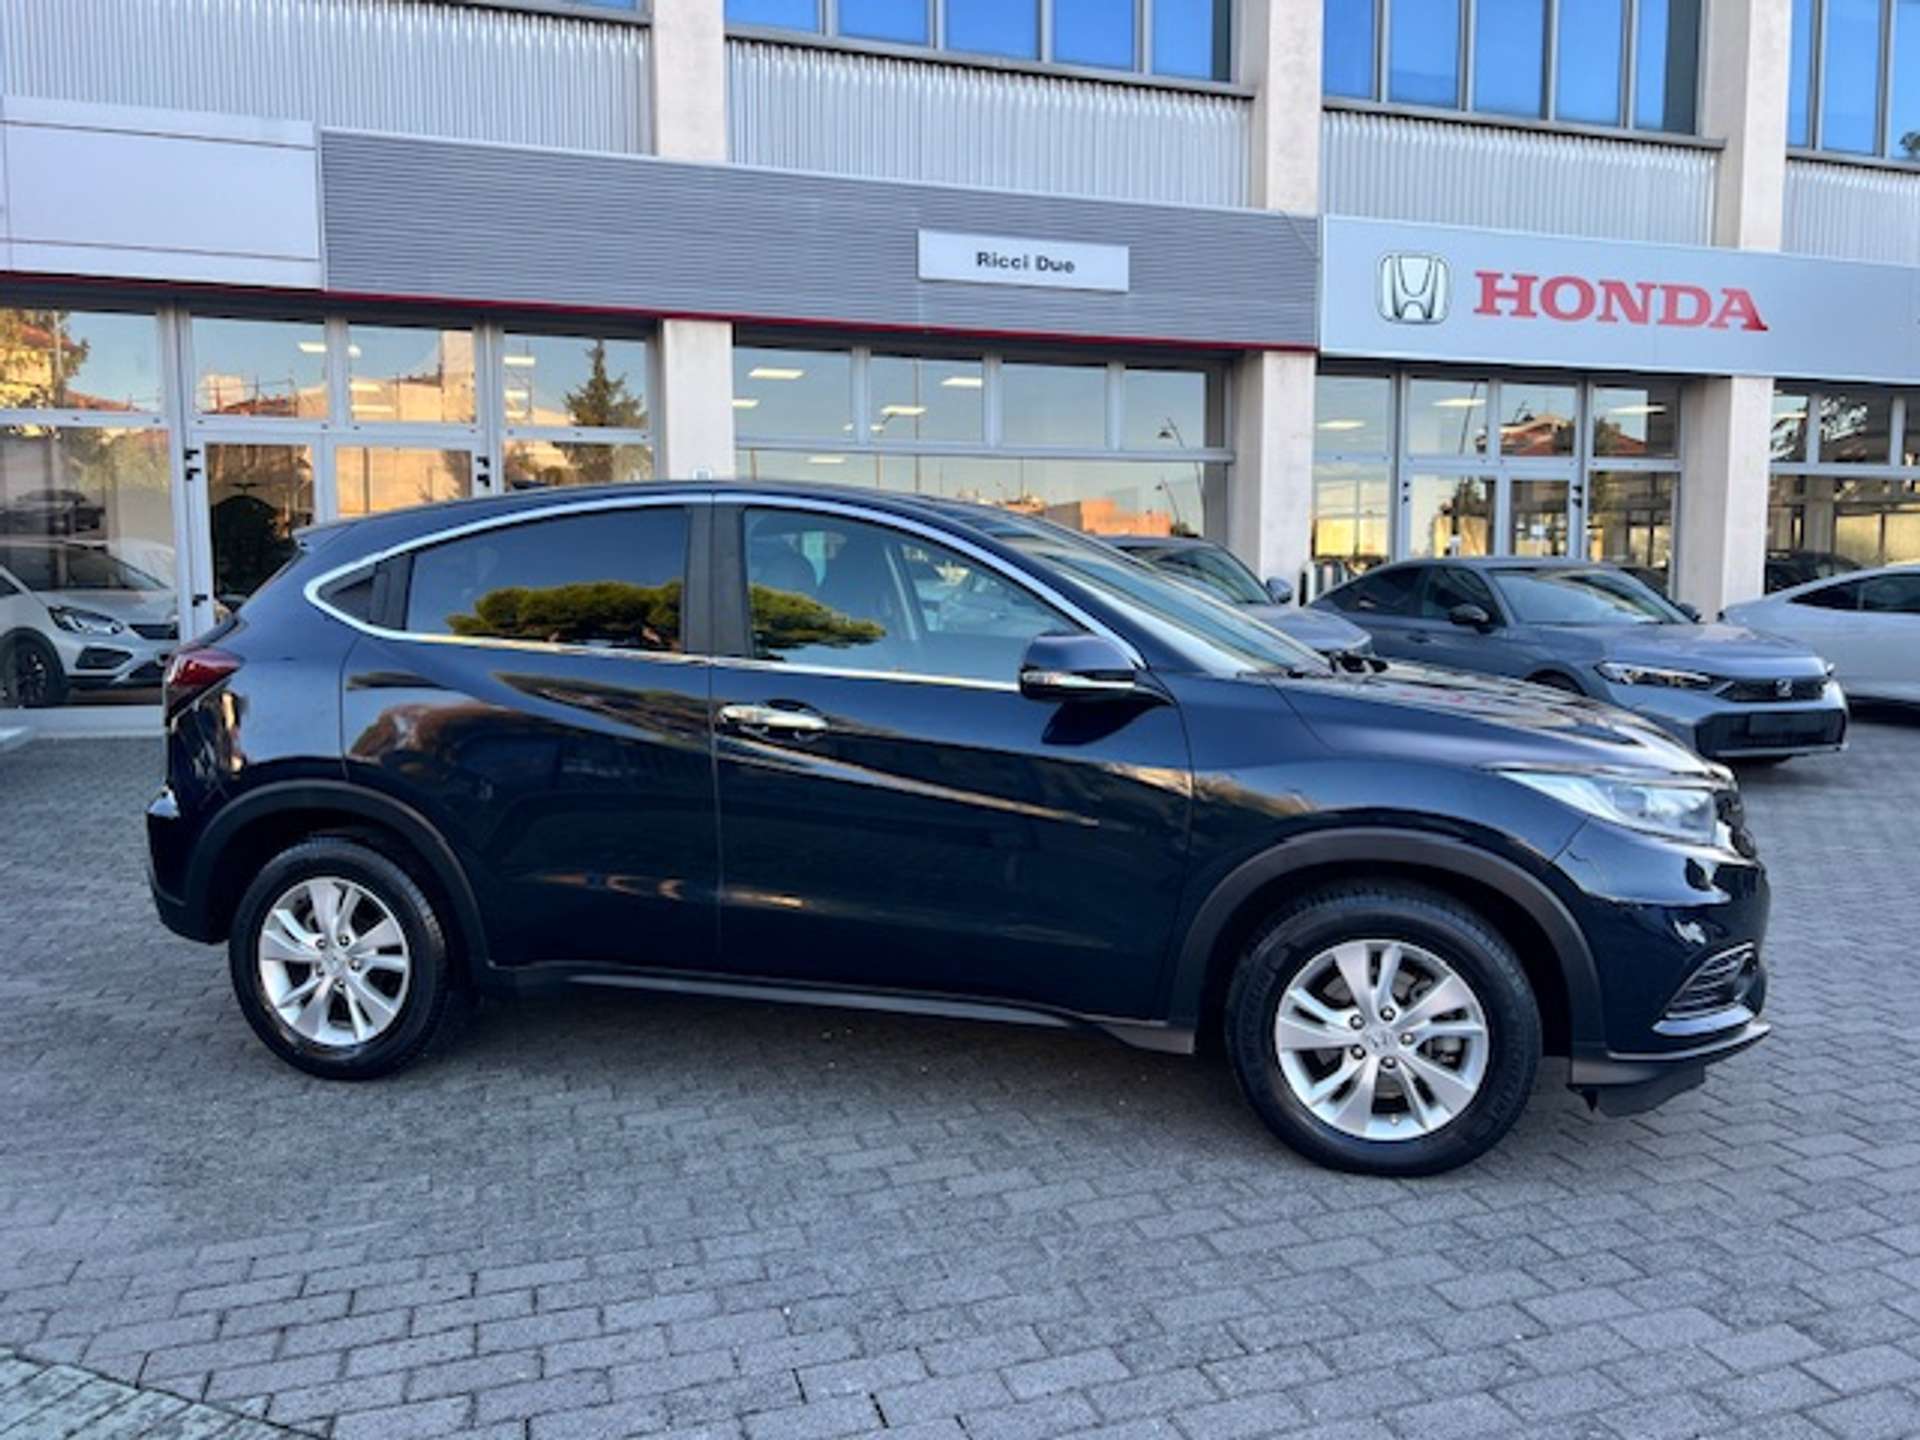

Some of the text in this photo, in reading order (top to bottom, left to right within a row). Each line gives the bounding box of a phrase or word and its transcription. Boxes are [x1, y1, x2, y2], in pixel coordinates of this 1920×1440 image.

[976, 251, 1075, 273] Ricci Due
[1473, 270, 1768, 332] HONDA
